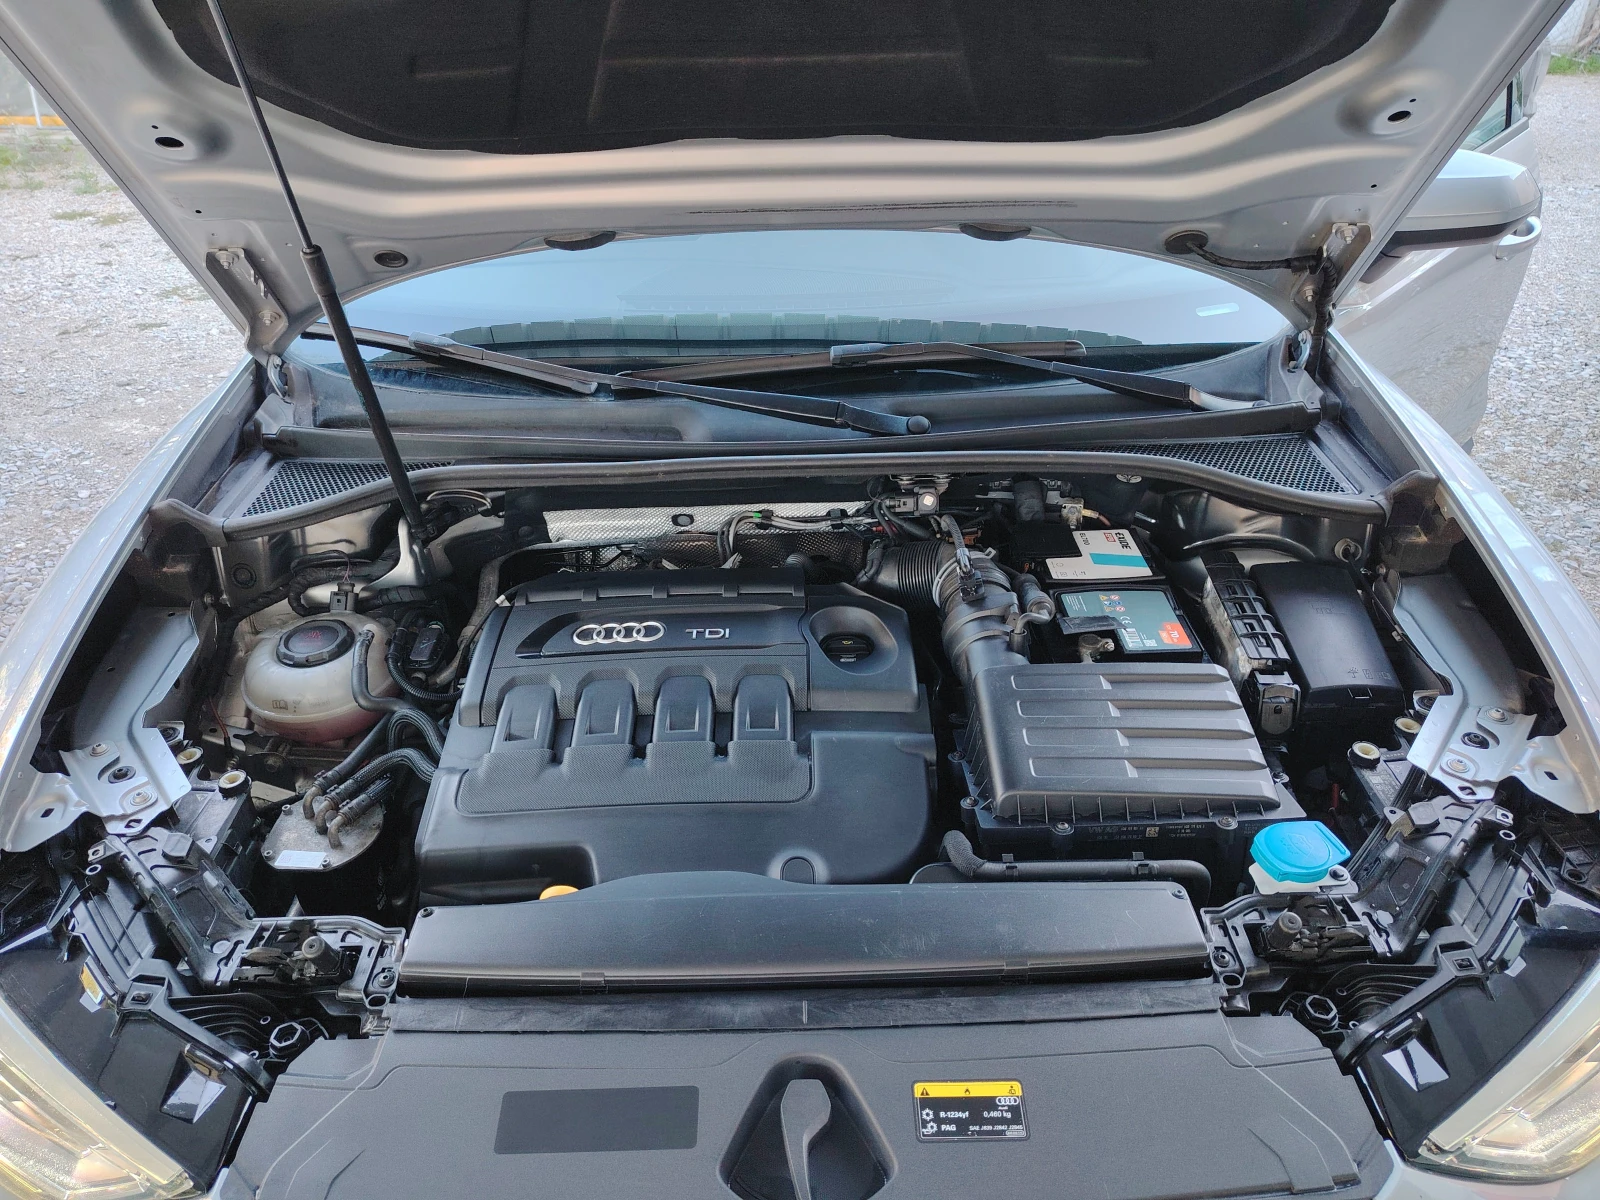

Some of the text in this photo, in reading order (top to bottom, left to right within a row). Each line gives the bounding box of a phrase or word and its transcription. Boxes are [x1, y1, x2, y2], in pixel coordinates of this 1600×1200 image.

[1115, 532, 1131, 550] EXIDE
[685, 628, 730, 639] TDI
[939, 1111, 969, 1119] R-1234yf
[941, 1124, 956, 1132] PAG
